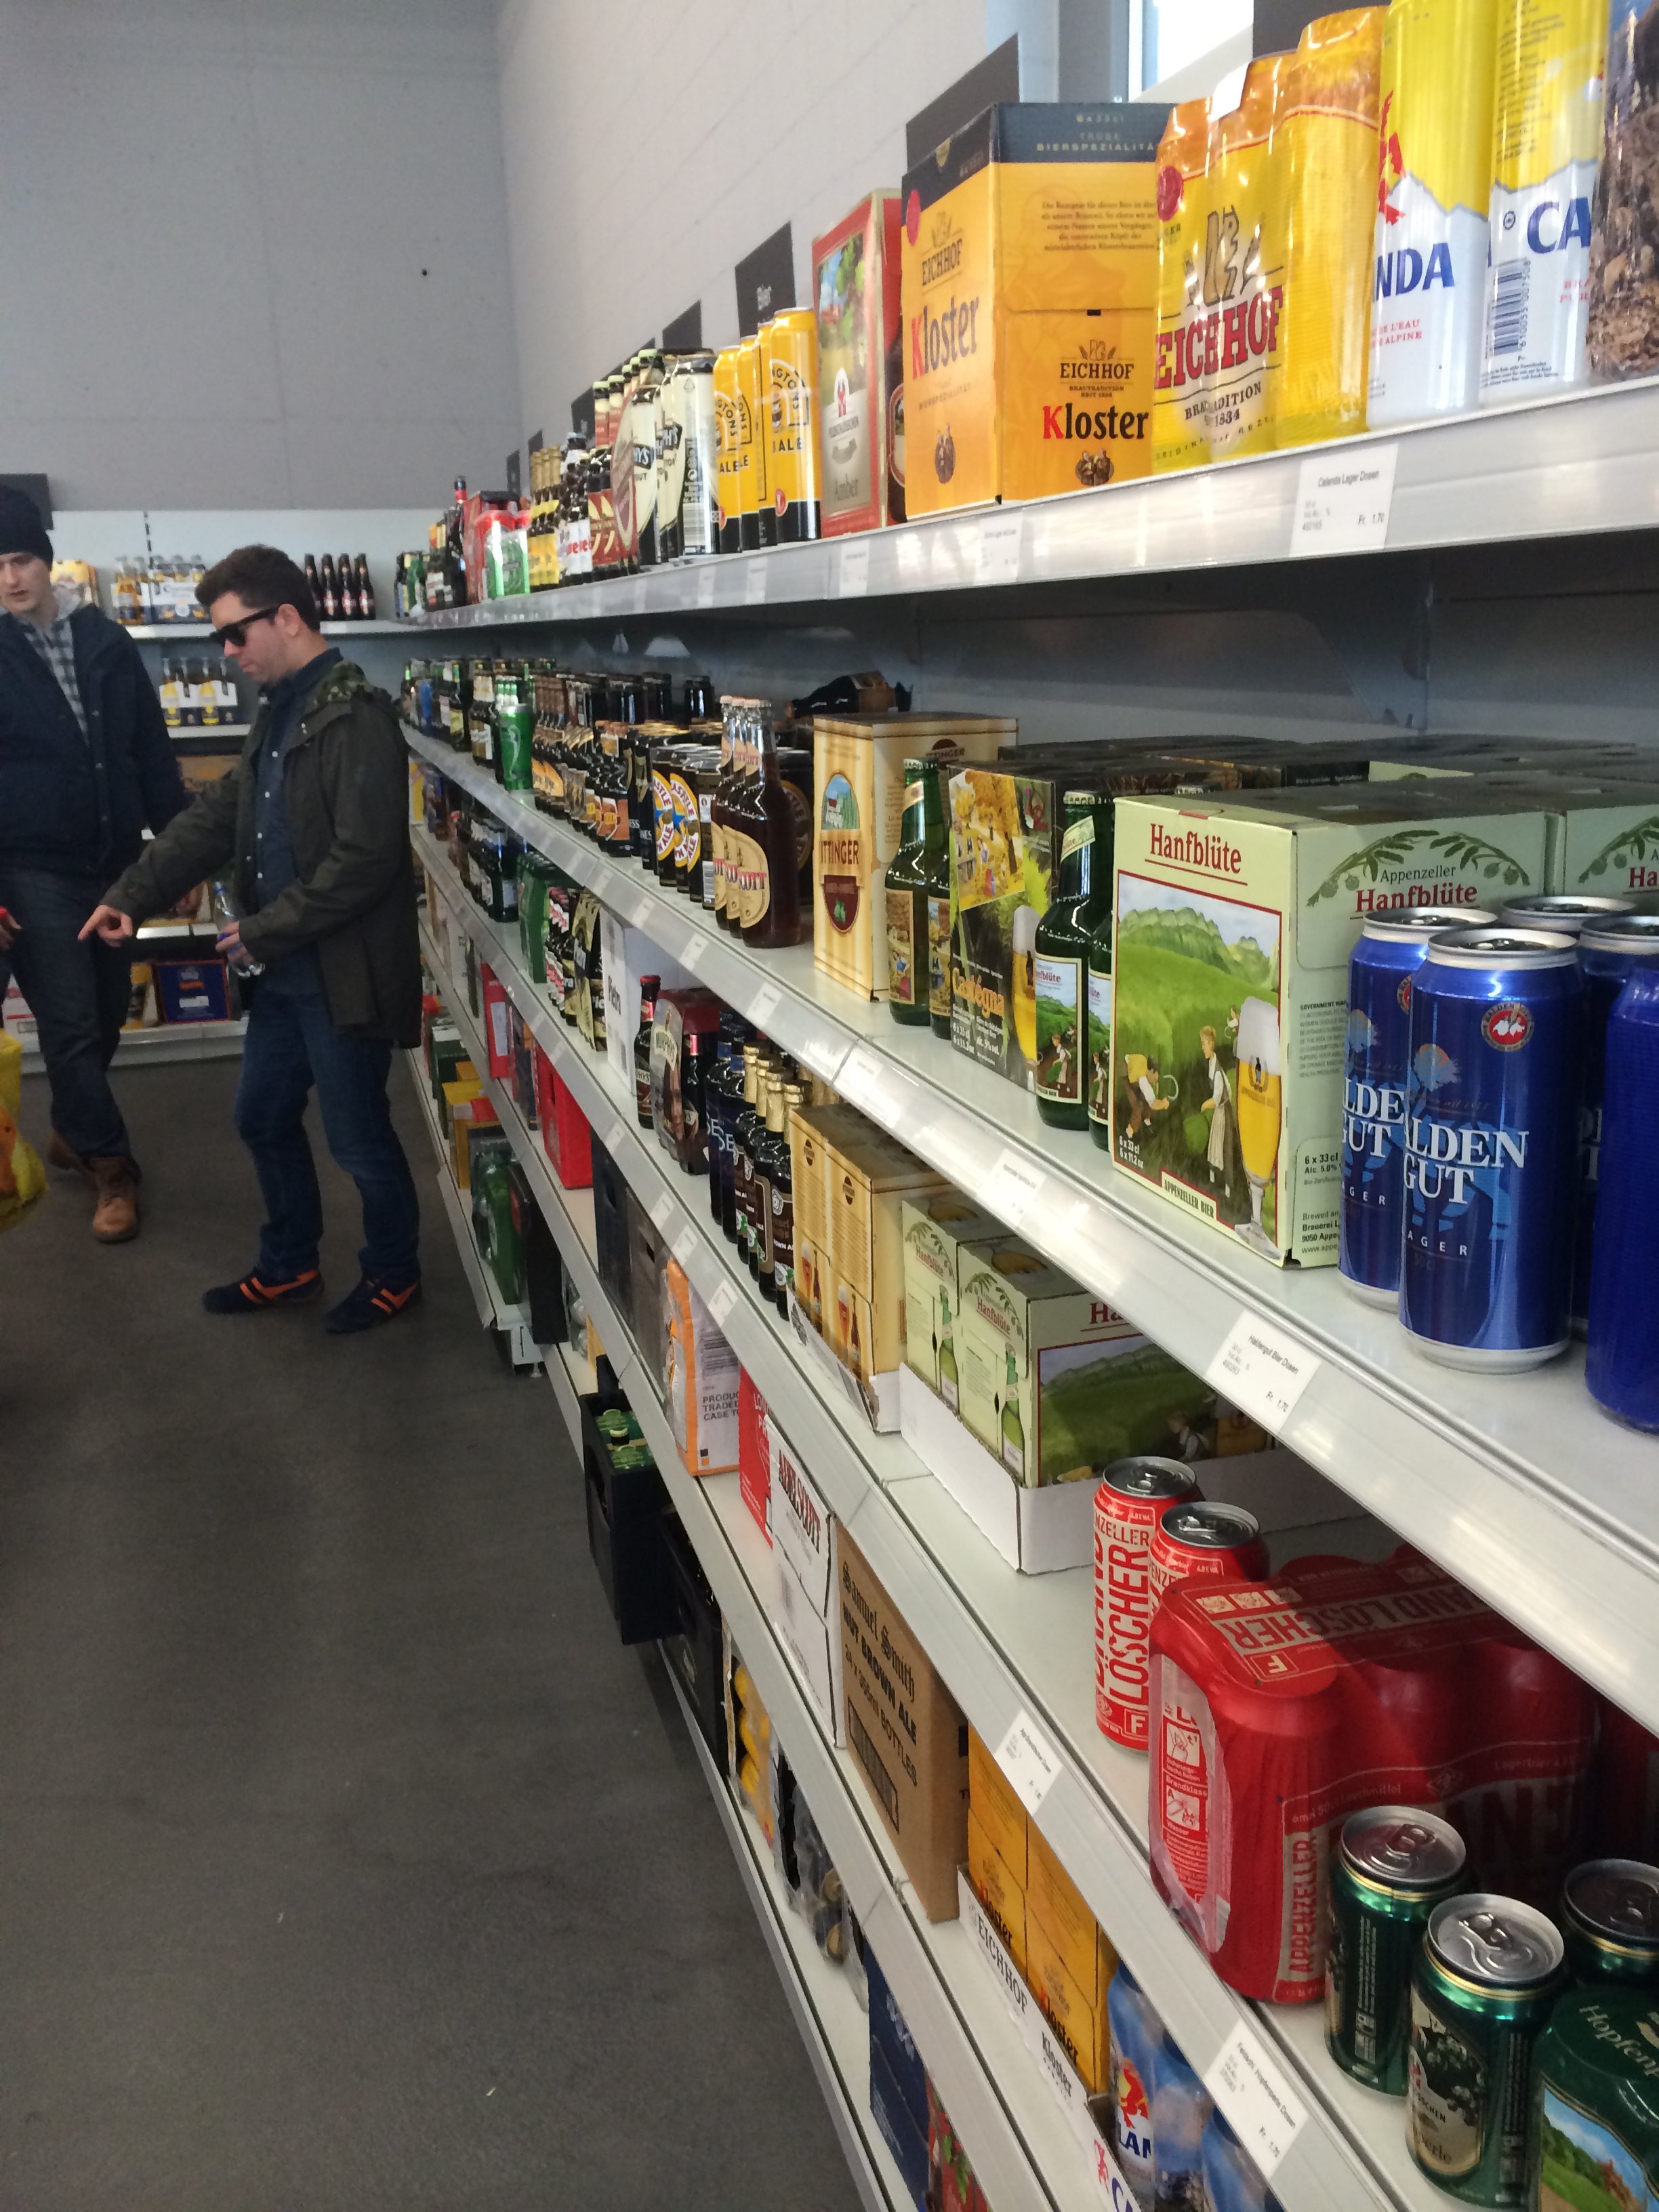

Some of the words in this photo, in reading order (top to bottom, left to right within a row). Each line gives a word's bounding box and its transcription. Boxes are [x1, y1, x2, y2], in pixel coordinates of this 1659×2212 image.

[1528, 197, 1591, 253] CA
[922, 239, 963, 286] EICHHOF
[911, 295, 979, 380] Kloster
[1153, 285, 1284, 391] EICHHOF
[1059, 362, 1134, 380] EICHHOF
[1042, 403, 1149, 440] Kloster
[820, 839, 859, 865] ITTINGER
[1150, 823, 1242, 874] Hanfblüte
[1380, 865, 1456, 884] Appenzeller
[1629, 867, 1658, 888] Ha
[1355, 882, 1478, 912] Hanfblüte
[1119, 1135, 1123, 1146] 6
[1128, 1139, 1134, 1152] 33
[1305, 1155, 1309, 1164] 6
[1319, 1154, 1329, 1163] 33
[1404, 1152, 1475, 1205] GUT
[1164, 1179, 1199, 1210] APPENZELLER
[1201, 1200, 1214, 1219] BIER
[1303, 1211, 1329, 1221] Brewed
[1302, 1221, 1333, 1232] Brauerei
[916, 1245, 944, 1276] Hanfblüte
[977, 1296, 1012, 1335] Hanfblüte
[842, 1560, 879, 1641] Samuel
[880, 1624, 915, 1703] Smith
[1105, 1544, 1149, 1706] LÖSCHER
[842, 1601, 859, 1644] NUT
[861, 1634, 896, 1710] BROWN
[898, 1699, 917, 1747] ALE
[1130, 1714, 1147, 1734] F
[880, 1707, 918, 1788] BOTTLES
[977, 1912, 1028, 2015] EICHHOF
[1042, 2031, 1073, 2097] Kloster
